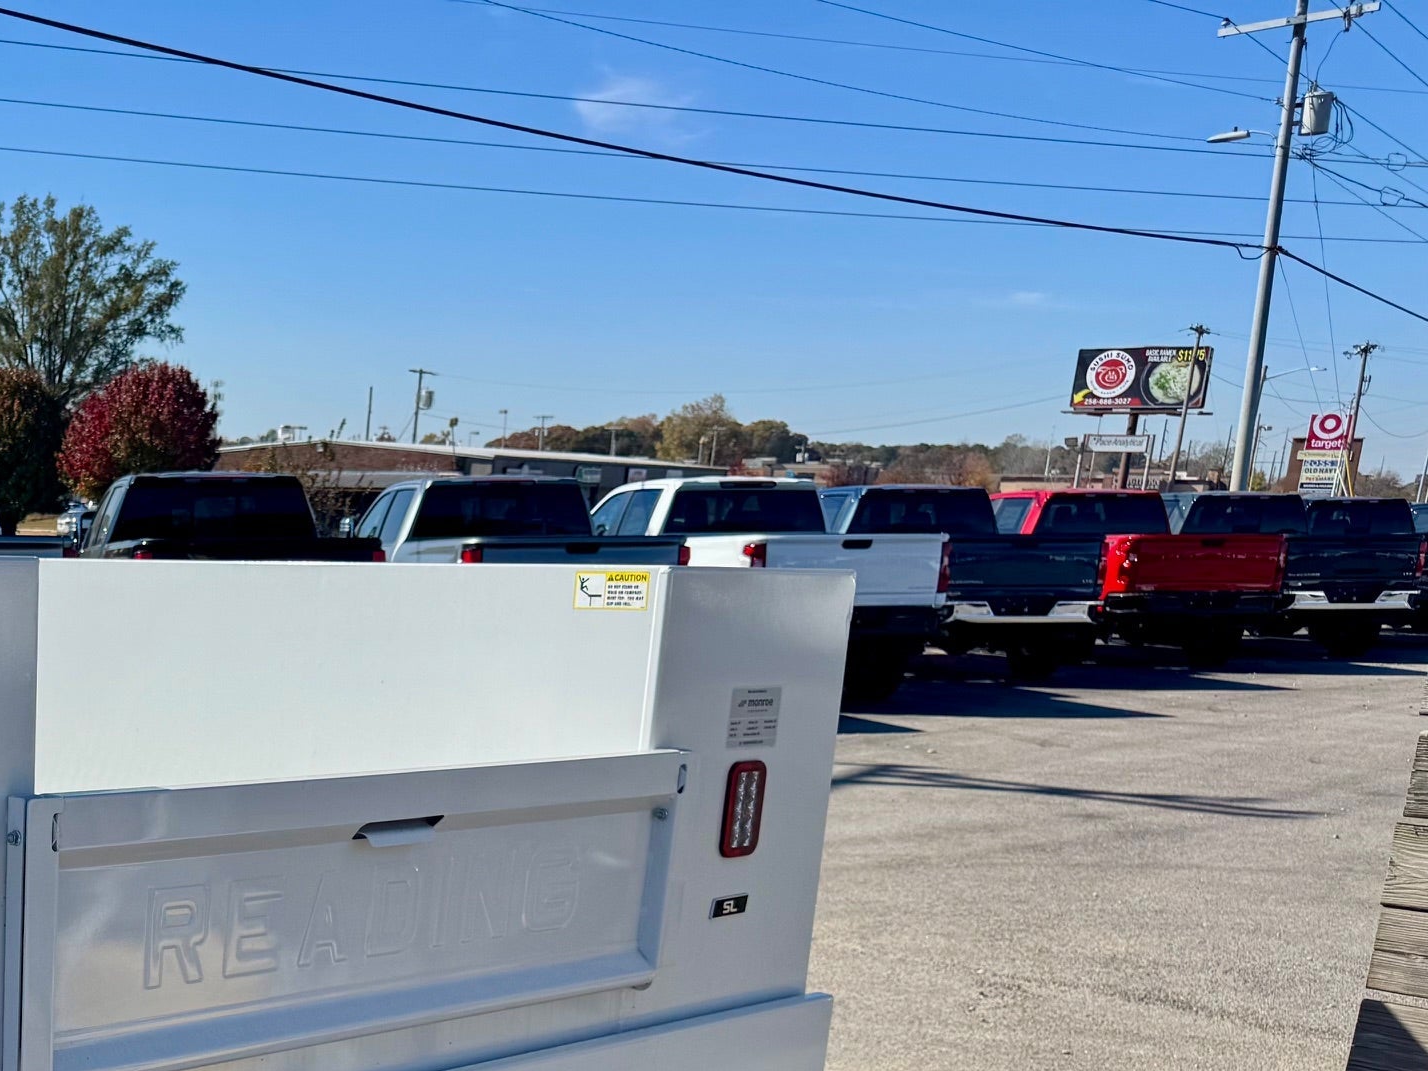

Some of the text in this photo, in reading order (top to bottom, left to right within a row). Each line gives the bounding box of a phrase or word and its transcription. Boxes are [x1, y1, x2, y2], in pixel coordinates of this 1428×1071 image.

[1090, 352, 1134, 371] SUSHI SUMO
[1311, 439, 1342, 449] target
[747, 698, 774, 708] monroe
[722, 900, 738, 914] SL
[143, 852, 581, 990] READING
